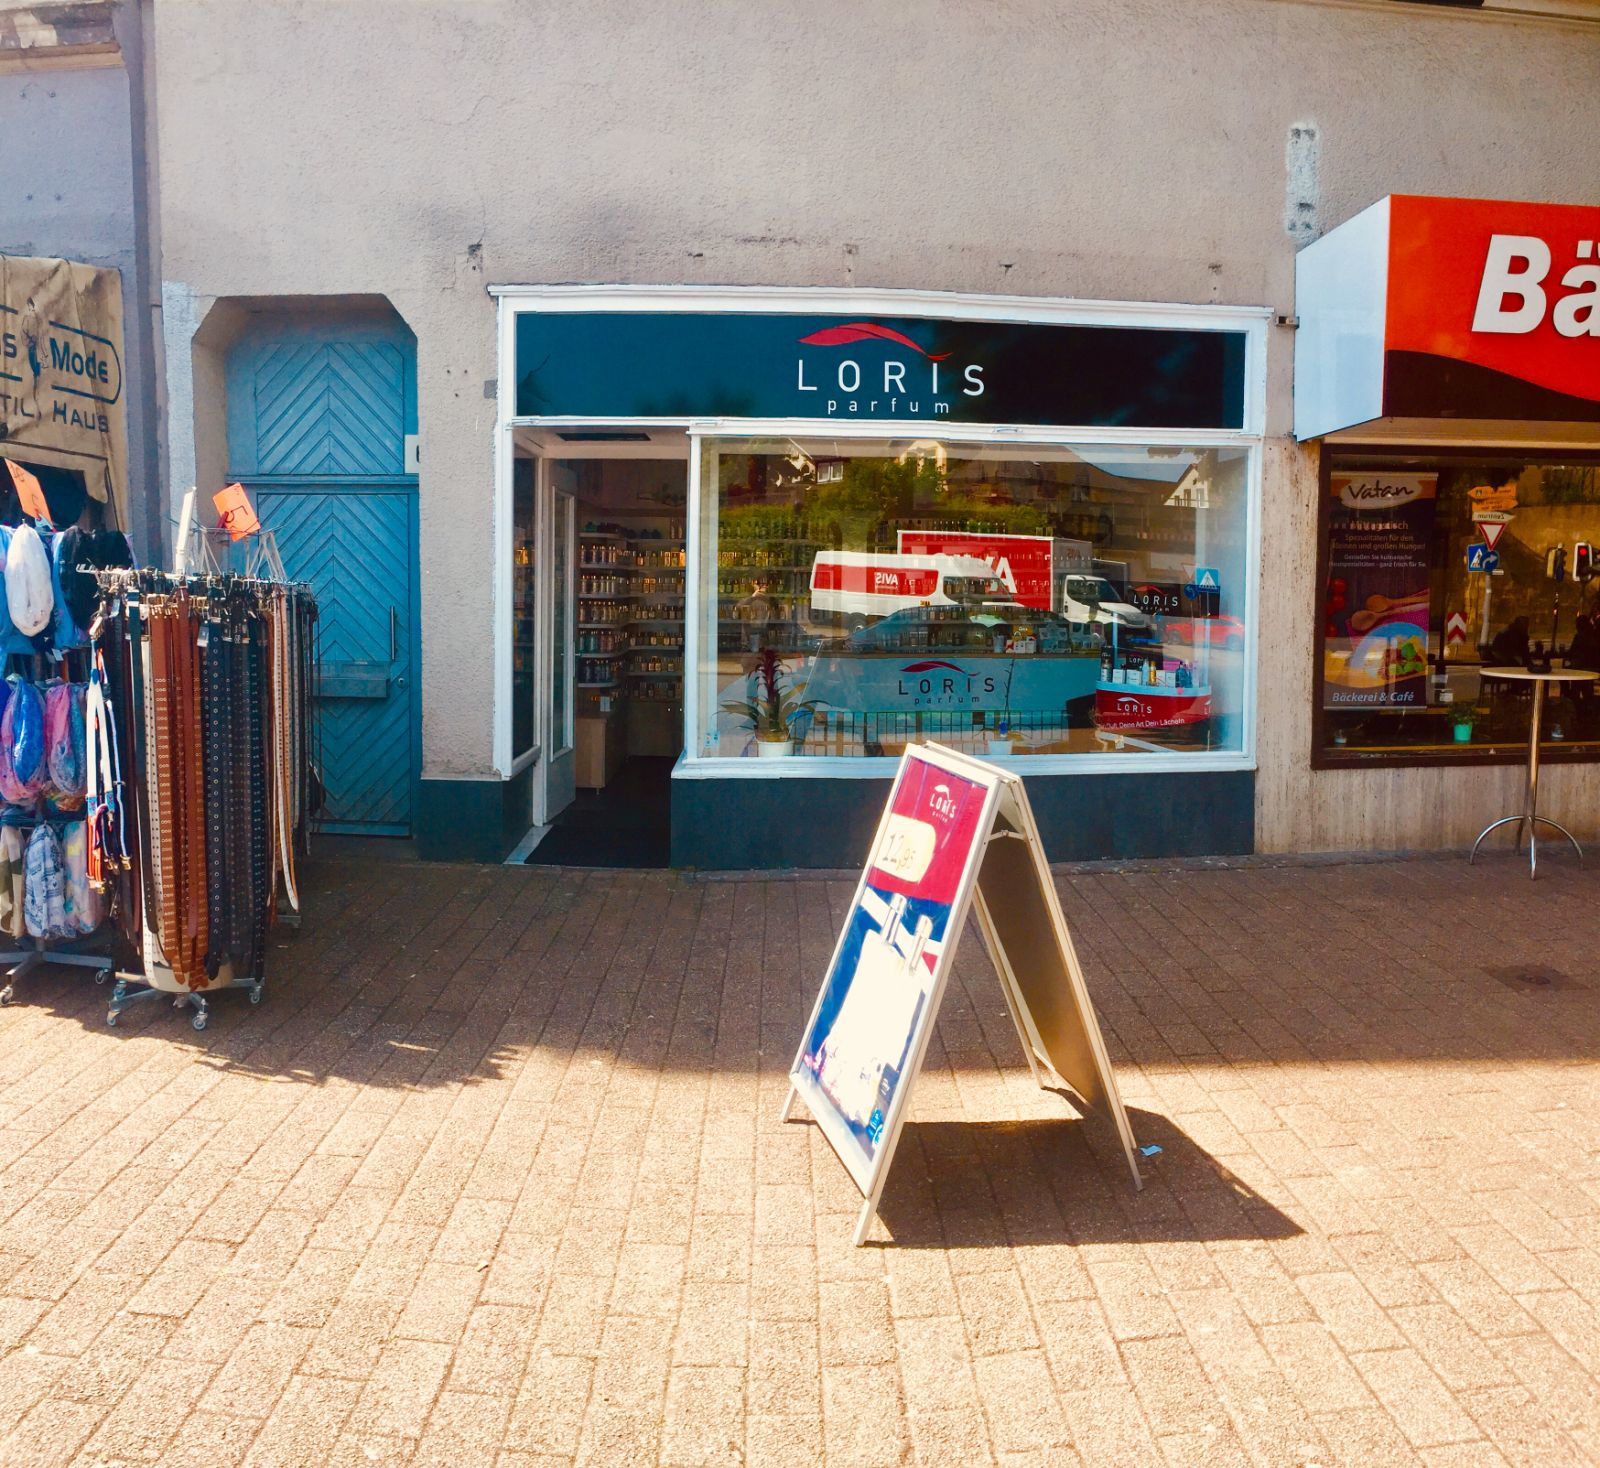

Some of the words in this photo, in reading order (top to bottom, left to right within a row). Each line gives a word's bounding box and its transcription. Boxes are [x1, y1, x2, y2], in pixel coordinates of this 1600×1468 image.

[49, 337, 109, 384] Mode
[798, 359, 985, 396] LORIS
[827, 397, 949, 415] parfum
[52, 400, 109, 433] HAUS
[1348, 479, 1414, 500] Vatan
[1133, 593, 1179, 607] LORIS
[898, 677, 995, 696] LORIS
[914, 696, 980, 705] parfum
[1332, 692, 1378, 702] Bäckerei
[1379, 691, 1388, 702] &
[1390, 691, 1415, 702] Café
[1117, 702, 1153, 714] LORIS
[930, 793, 957, 818] LORIS
